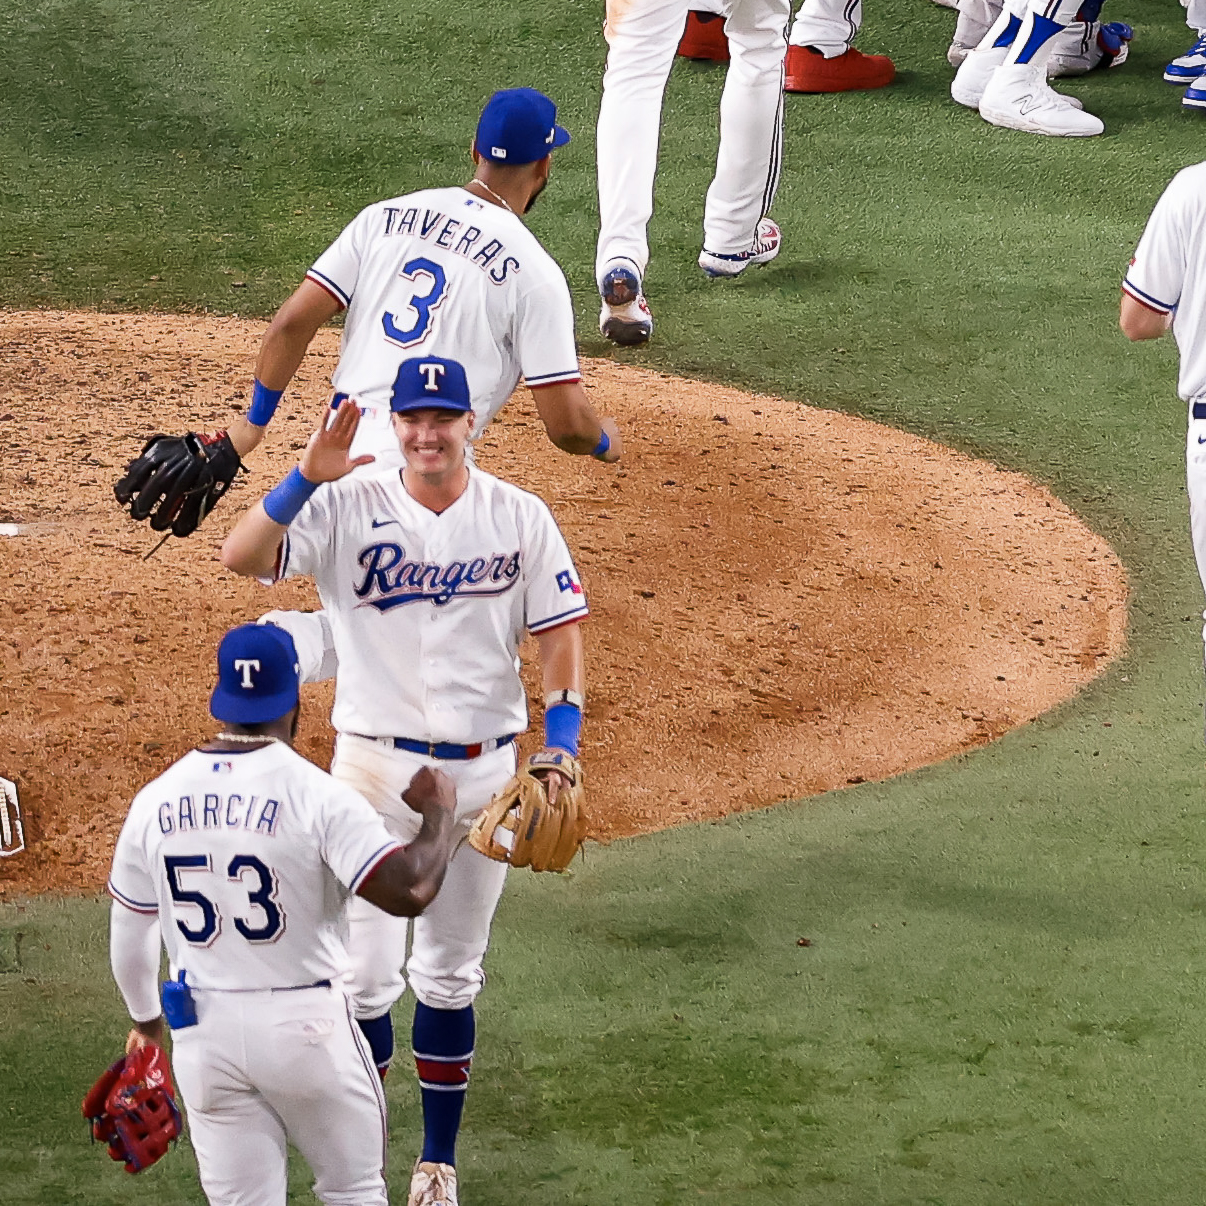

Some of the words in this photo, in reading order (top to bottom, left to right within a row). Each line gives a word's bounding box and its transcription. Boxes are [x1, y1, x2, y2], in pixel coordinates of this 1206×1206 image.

[383, 207, 521, 286] TAVERAS
[382, 257, 451, 350] 3
[419, 364, 445, 391] T
[353, 540, 521, 613] Rangers
[234, 659, 260, 688] T
[159, 792, 281, 837] GARCIA
[164, 854, 286, 948] 53
